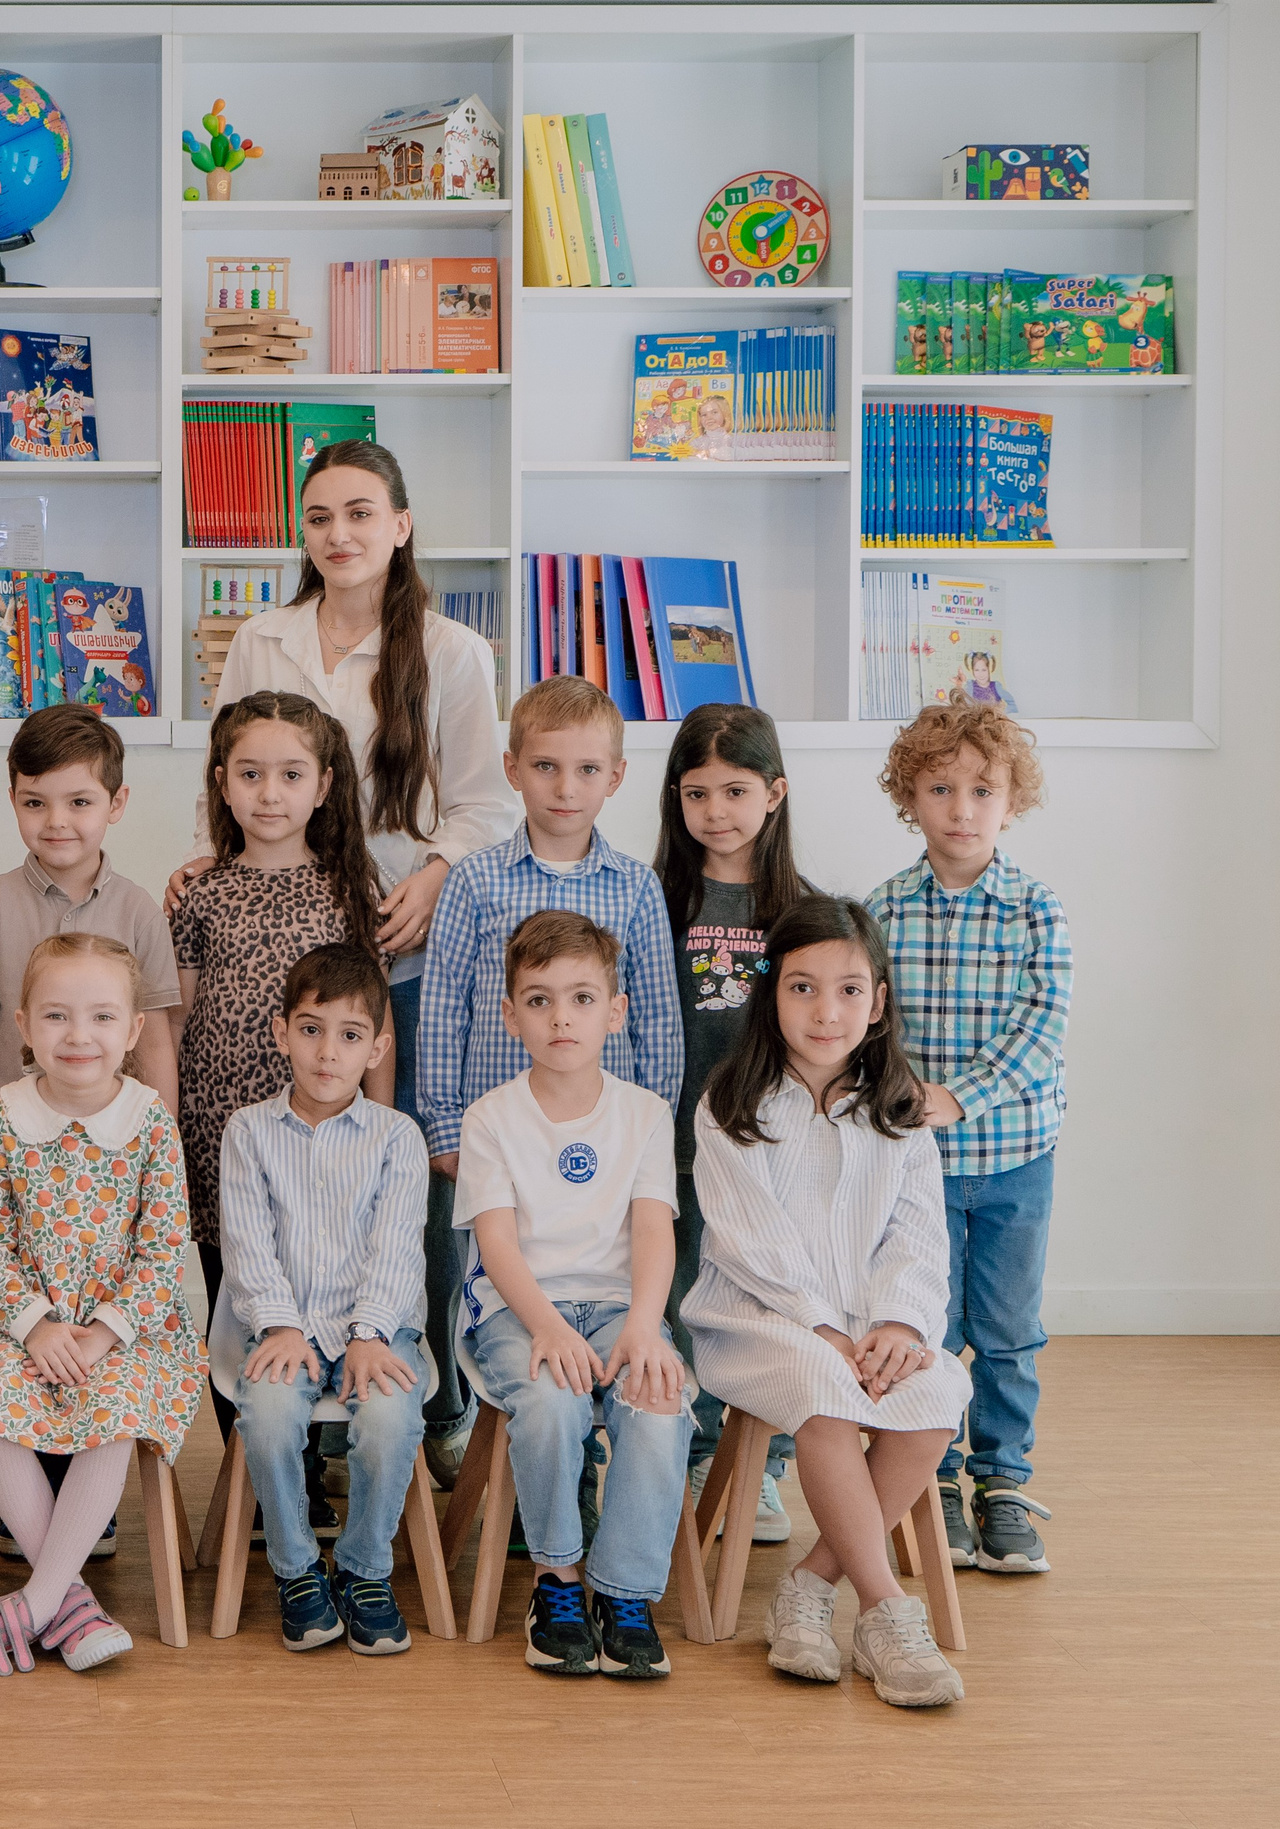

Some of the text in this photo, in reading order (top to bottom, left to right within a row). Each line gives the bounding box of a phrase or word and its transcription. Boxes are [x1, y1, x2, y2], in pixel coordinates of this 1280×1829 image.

[754, 182, 769, 194] 12
[784, 185, 790, 196] 1
[730, 192, 743, 203] 11
[802, 202, 811, 212] 2
[710, 210, 724, 222] 10
[768, 212, 789, 228] MINUTE
[808, 228, 817, 238] 3
[709, 238, 718, 249] 9
[760, 242, 768, 259] HOUR
[802, 250, 812, 260] 4
[714, 260, 724, 270] 8
[734, 275, 742, 286] 7
[784, 270, 794, 281] 5
[760, 278, 770, 287] 6
[1048, 278, 1094, 294] Super
[1052, 292, 1116, 309] Safari
[1136, 338, 1146, 347] 3
[645, 352, 724, 369] От А до Я
[10, 435, 94, 458] ԱՅԲԲԵՆԱՐԱՆ
[989, 436, 1038, 456] Большая
[996, 454, 1029, 469] книга
[940, 594, 984, 606] ПРОПИСИ
[932, 605, 992, 616] по математике
[74, 634, 138, 648] ՄԱԹԵՄԱՏԻԿԱ
[688, 926, 764, 940] HELLO KITTY
[686, 938, 767, 953] AND FRIENDS
[567, 1172, 592, 1182] SPORT
